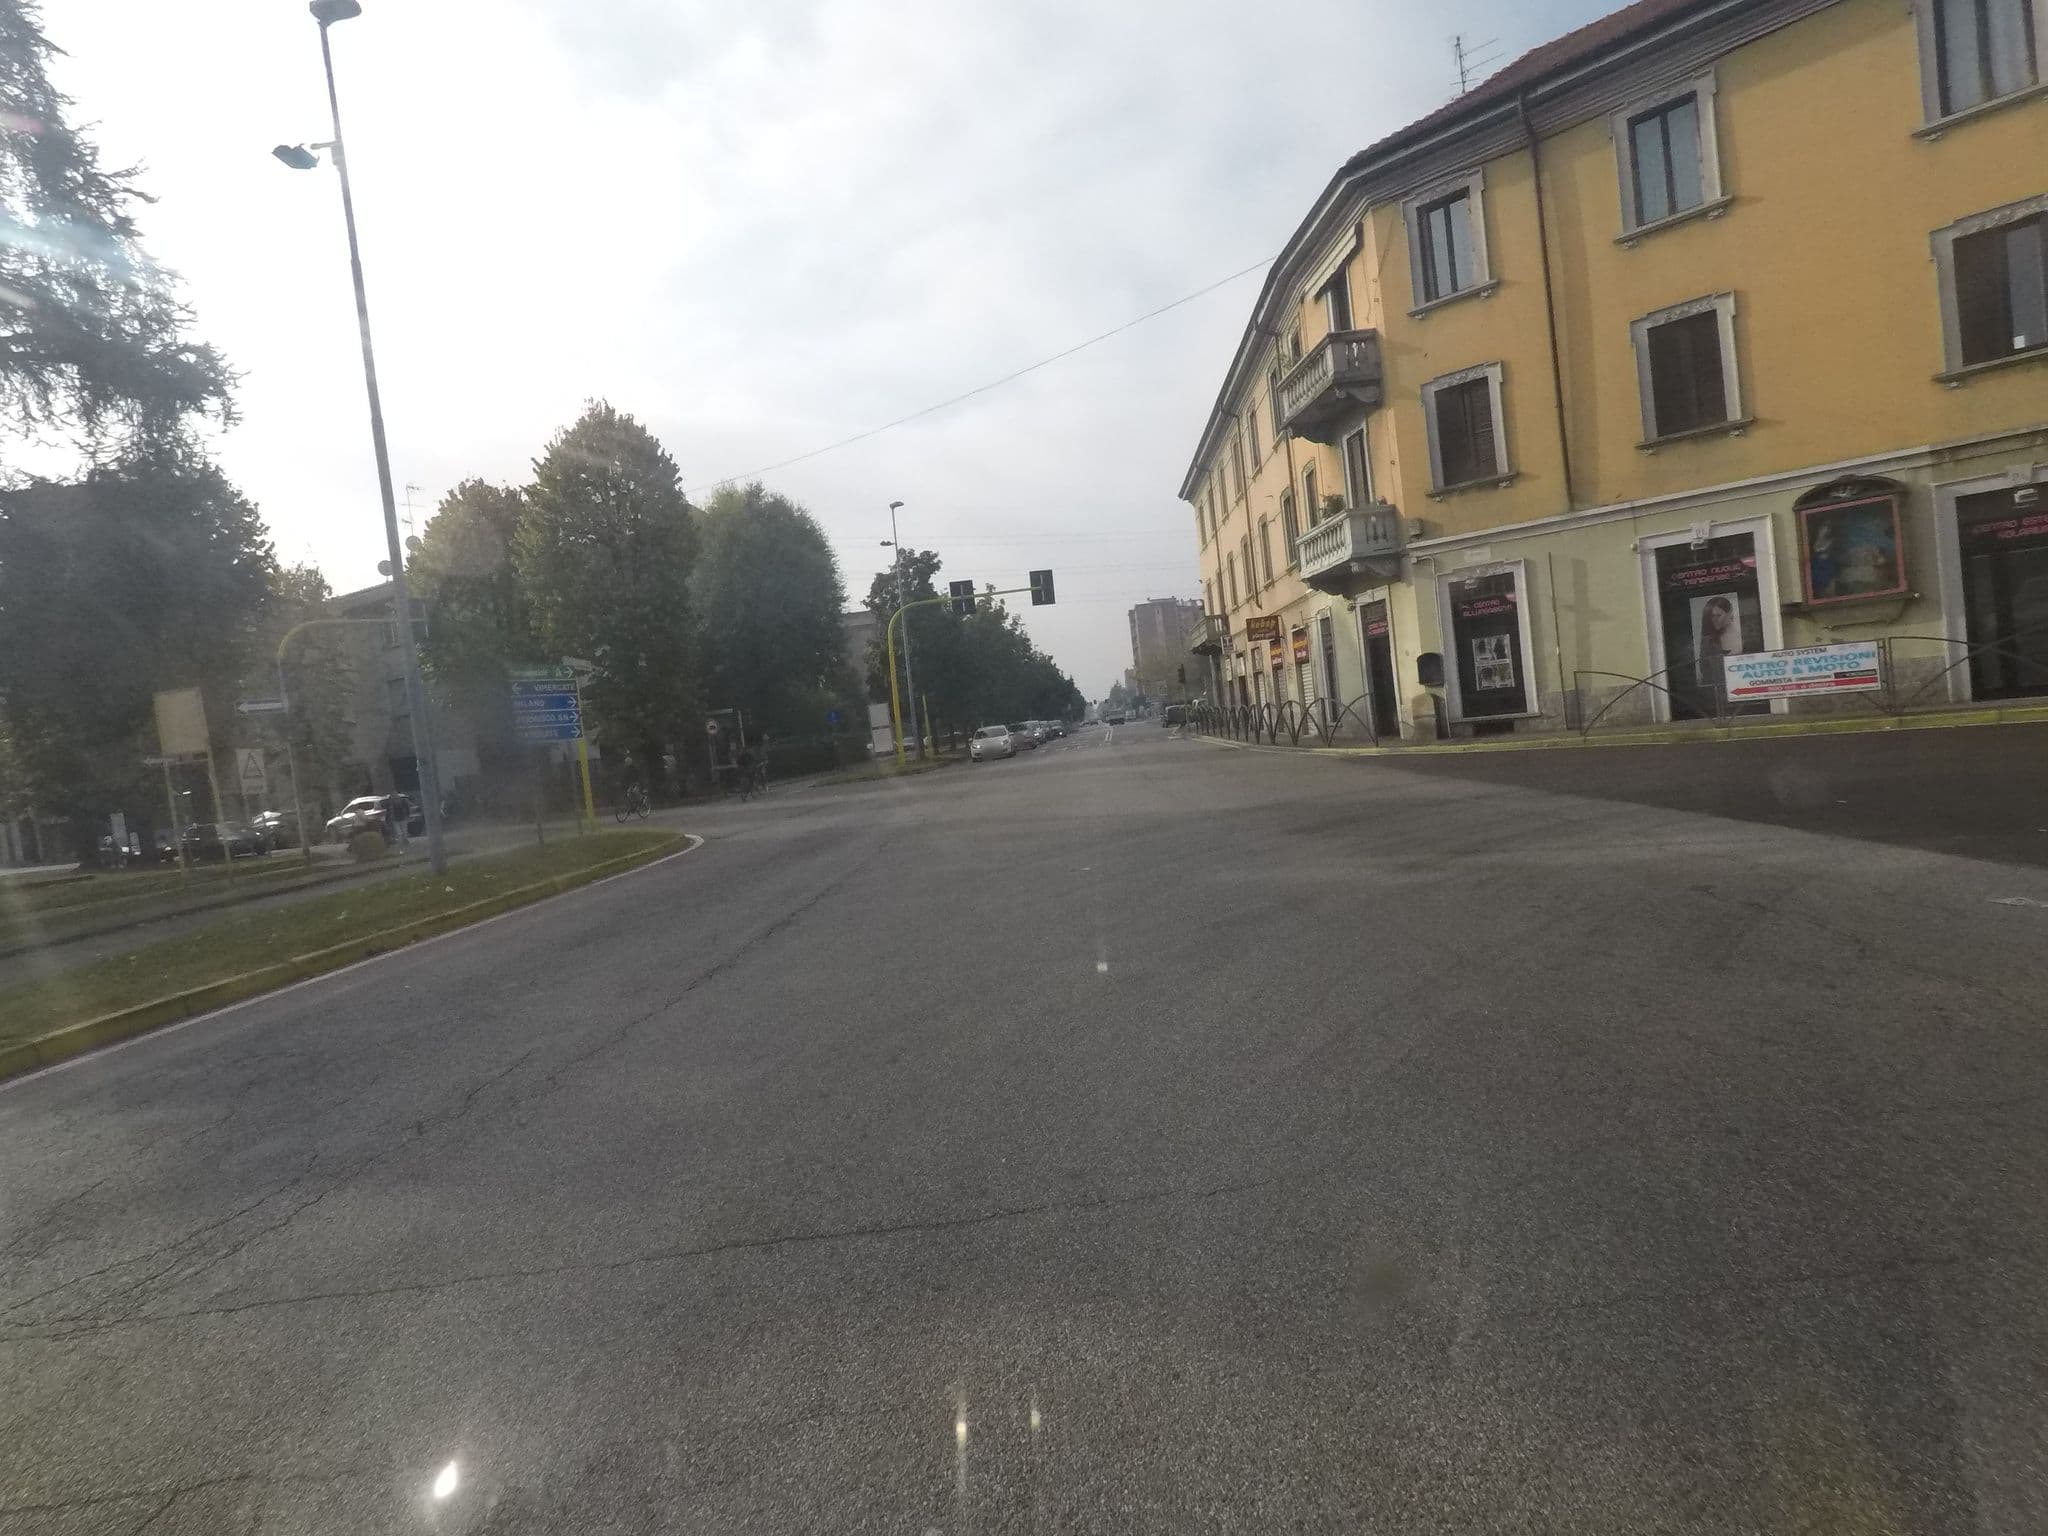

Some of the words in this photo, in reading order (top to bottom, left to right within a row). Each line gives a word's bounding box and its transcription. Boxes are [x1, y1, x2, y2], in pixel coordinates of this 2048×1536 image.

[1671, 568, 1708, 581] CENTRO
[1771, 650, 1794, 658] AUTO
[1796, 647, 1828, 656] SYSTEM
[1727, 660, 1788, 673] CENTRO
[1793, 651, 1877, 666] REVISIONI
[1742, 668, 1786, 679] AUTO
[1792, 666, 1804, 675] &
[1808, 660, 1860, 673] MOTO
[1749, 677, 1793, 687] GOMMISTA
